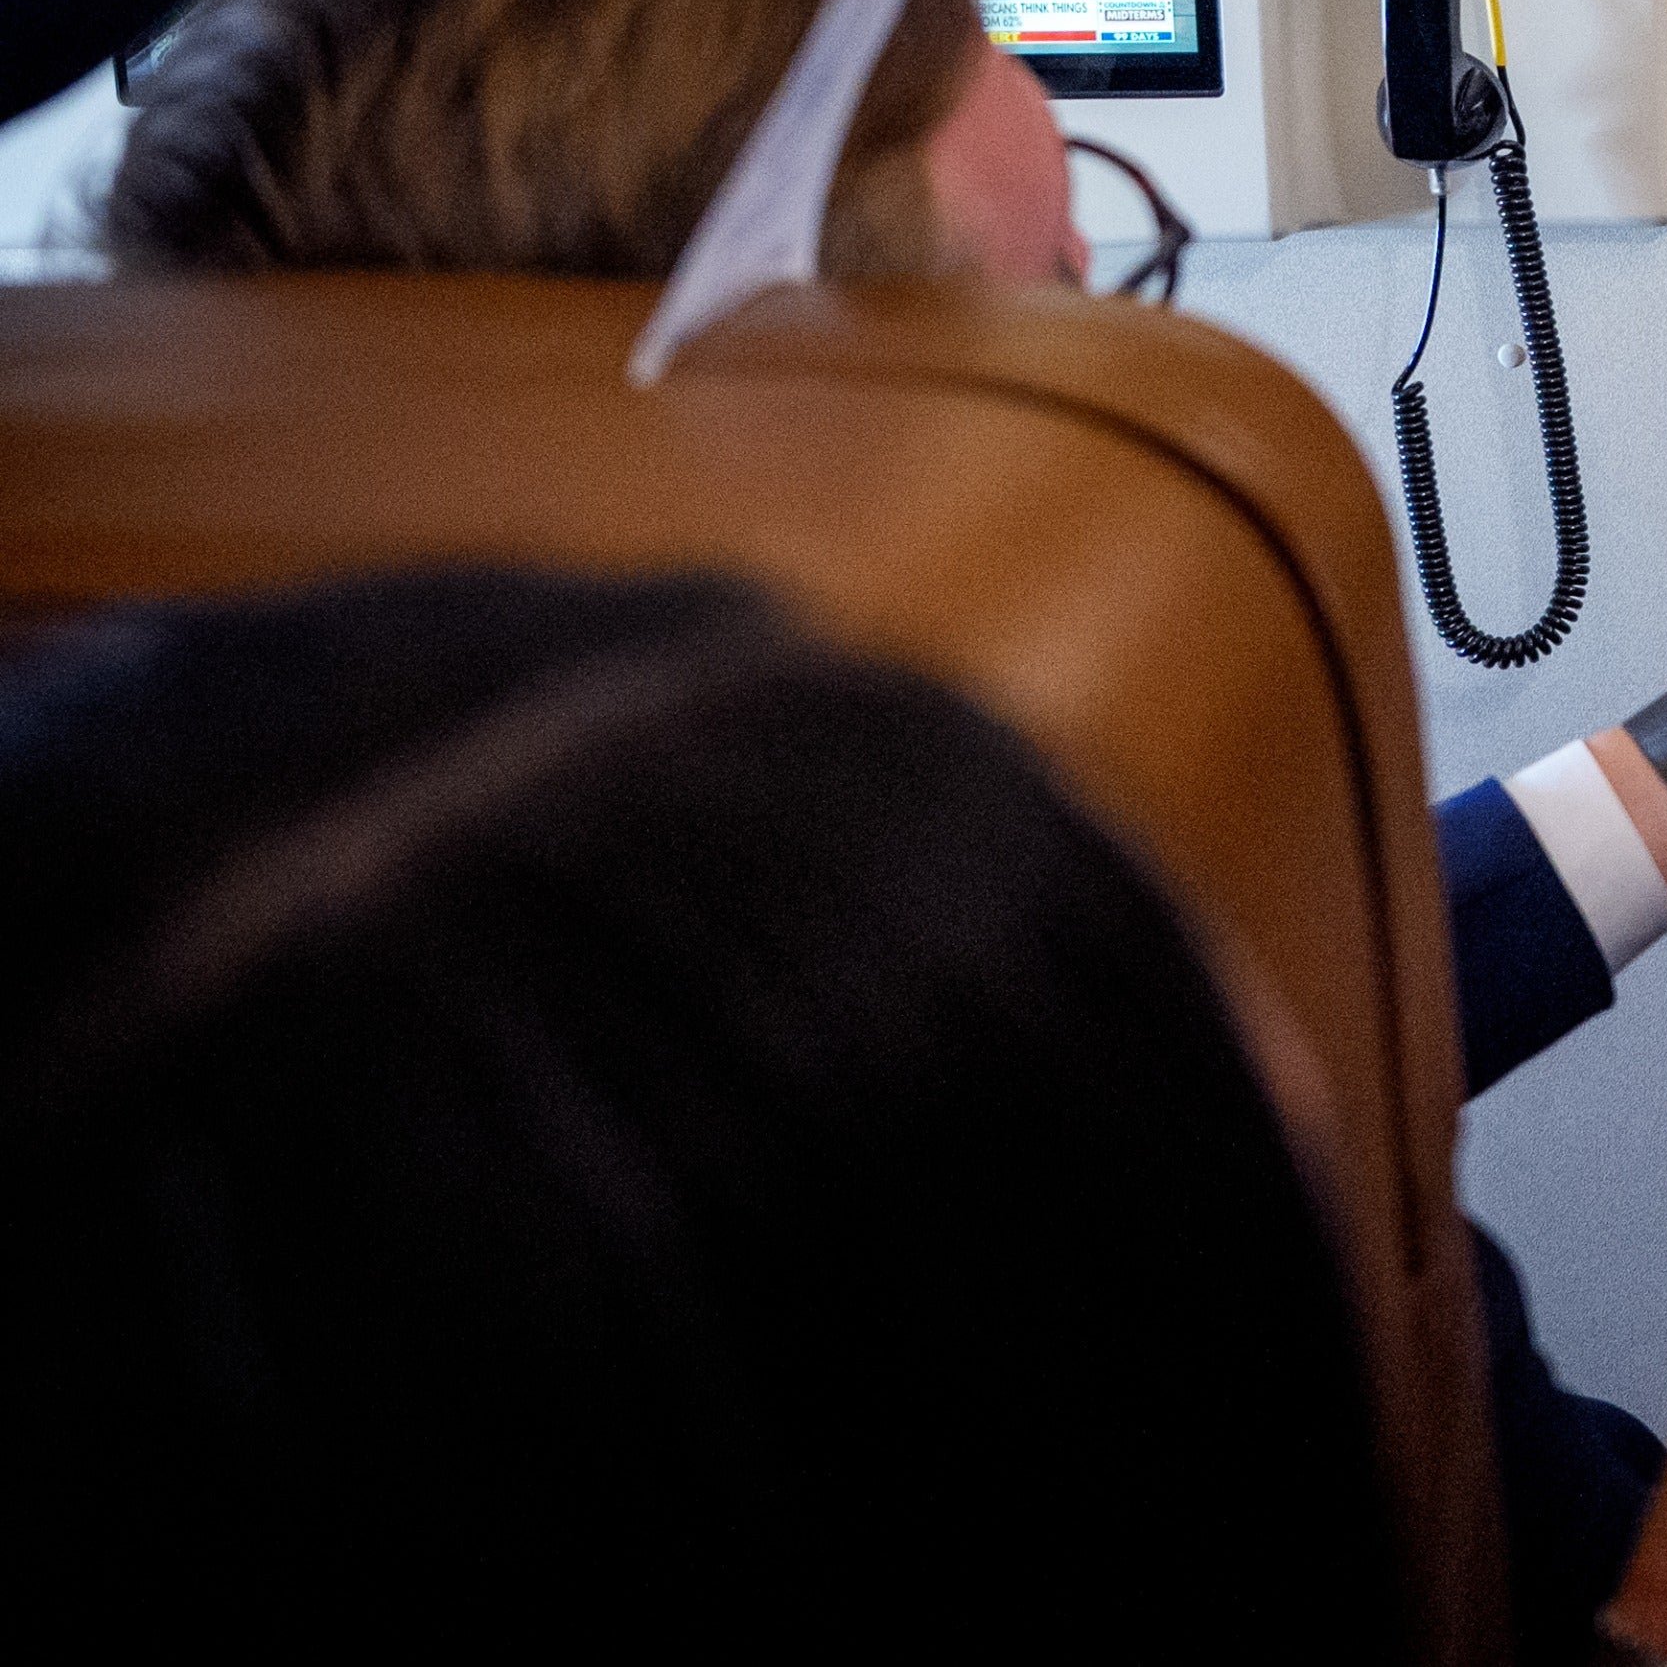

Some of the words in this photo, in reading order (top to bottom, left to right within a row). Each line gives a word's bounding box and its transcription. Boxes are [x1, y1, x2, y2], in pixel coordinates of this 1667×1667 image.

[1021, 2, 1049, 13] THINK
[1053, 2, 1088, 14] THINGS
[1104, 1, 1157, 9] COUNTDOWN
[1106, 10, 1164, 20] MIDTERMS
[1131, 32, 1160, 41] DAYS
